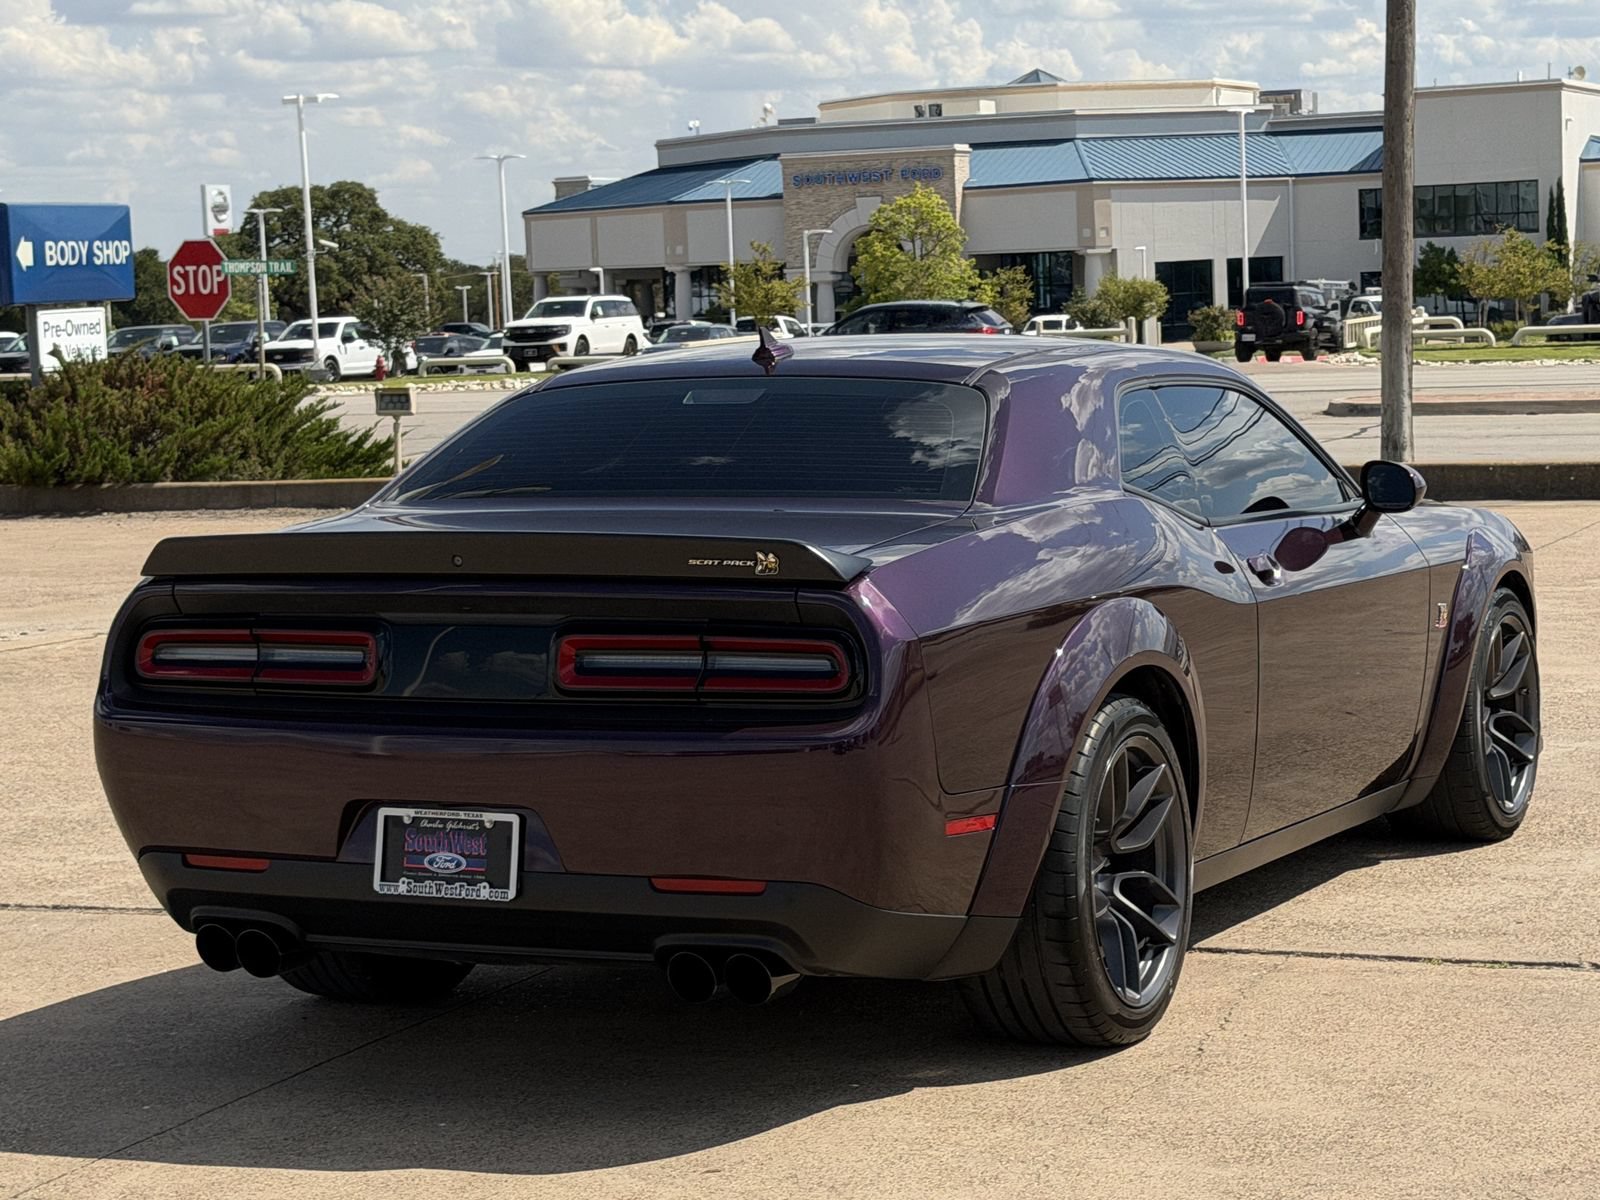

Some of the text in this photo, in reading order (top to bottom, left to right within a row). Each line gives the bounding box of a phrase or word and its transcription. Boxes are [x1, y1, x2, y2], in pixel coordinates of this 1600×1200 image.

[792, 167, 943, 187] SOUTHWEST FORD
[45, 239, 130, 267] BODY SHOP
[224, 261, 293, 273] THOMPSON TRAIL
[172, 265, 225, 295] STOP
[43, 318, 101, 338] Pre-Owned
[722, 559, 755, 567] PACK
[432, 856, 458, 870] Ford
